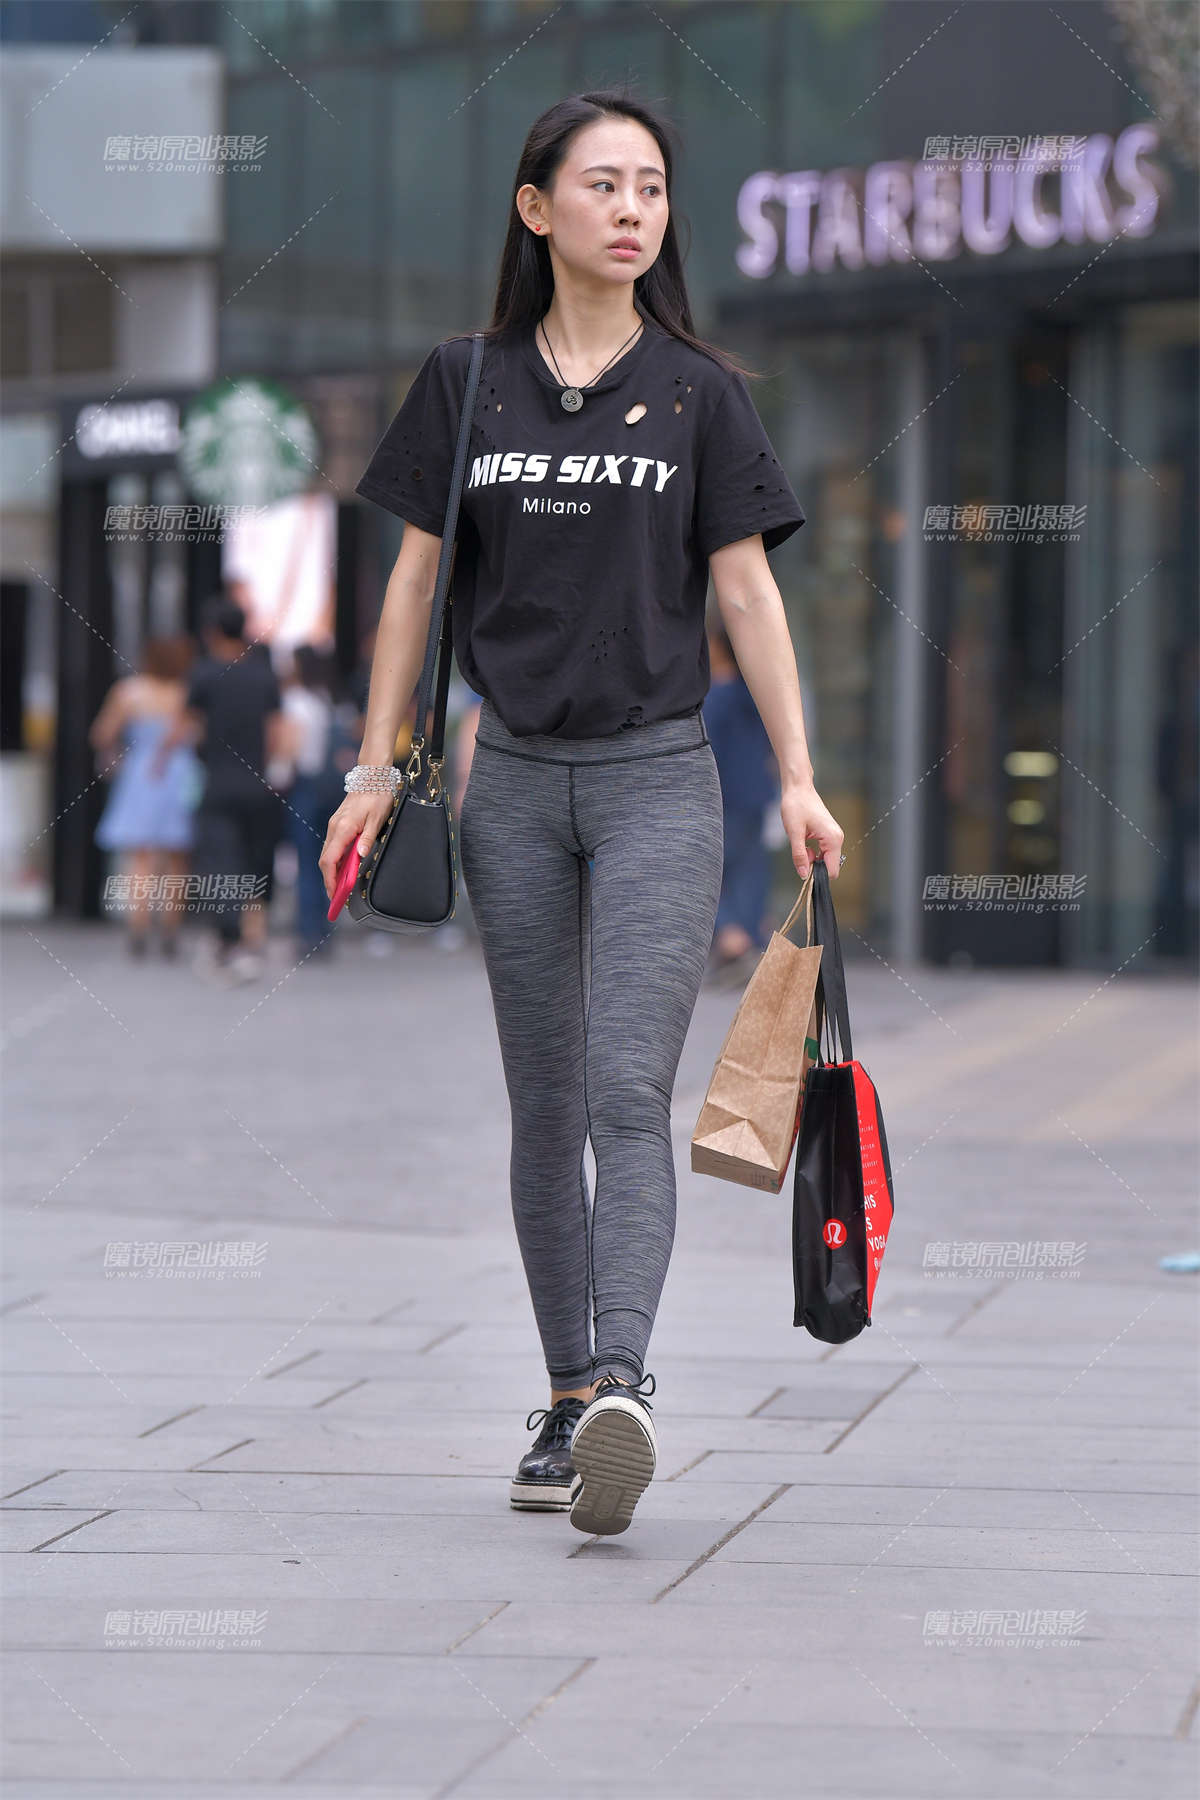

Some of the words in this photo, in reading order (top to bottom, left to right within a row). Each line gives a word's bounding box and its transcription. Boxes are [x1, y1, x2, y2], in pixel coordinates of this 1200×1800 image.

[735, 122, 1162, 280] STARBUCKS
[468, 452, 552, 488] MISS
[556, 454, 679, 493] SIXTY
[522, 497, 592, 515] Milano
[863, 1193, 877, 1211] HIS
